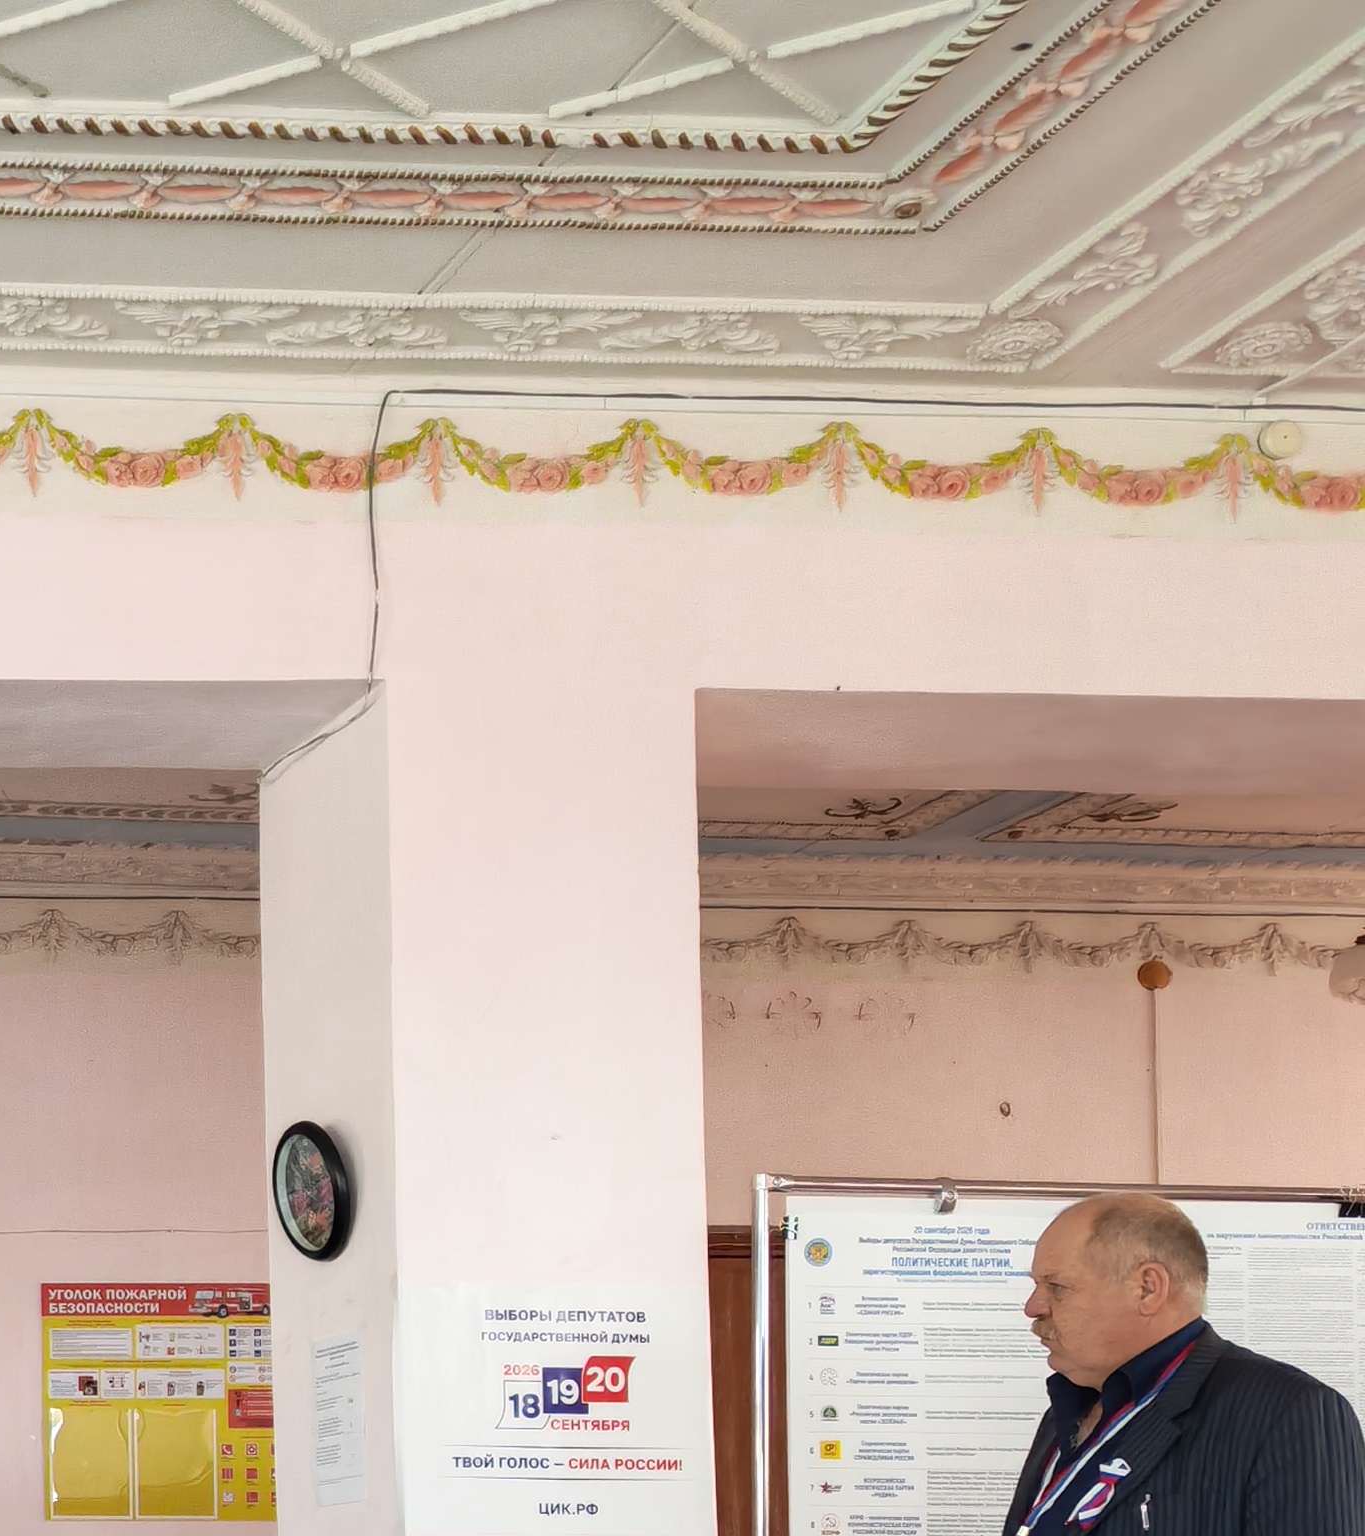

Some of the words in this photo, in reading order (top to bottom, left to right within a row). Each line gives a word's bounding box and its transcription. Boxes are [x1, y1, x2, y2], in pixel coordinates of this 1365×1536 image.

[891, 1257, 969, 1268] ПОЛИТИЧЕСКИЕ
[48, 1289, 102, 1301] УГОЛОК
[105, 1286, 188, 1300] ПОЖАРНОЙ
[48, 1302, 160, 1314] БЕЗОПАСНОСТИ
[484, 1309, 552, 1322] ВЫБОРЫ
[556, 1310, 647, 1324] ДЕПУТАТОВ
[481, 1330, 608, 1343] ГОСУДАРСТВЕННОЙ
[611, 1333, 651, 1344] ДУМЫ
[503, 1365, 540, 1376] 2026
[508, 1394, 541, 1418] 18
[546, 1379, 580, 1405] 19
[586, 1366, 626, 1393] 20
[550, 1419, 631, 1431] СЕНТЯБРЯ
[452, 1454, 495, 1469] ТВОЙ
[498, 1456, 550, 1469] ГОЛОС
[568, 1457, 610, 1470] СИЛА
[614, 1459, 683, 1471] РОССИИ!
[538, 1502, 599, 1516] ЦИК.РФ
